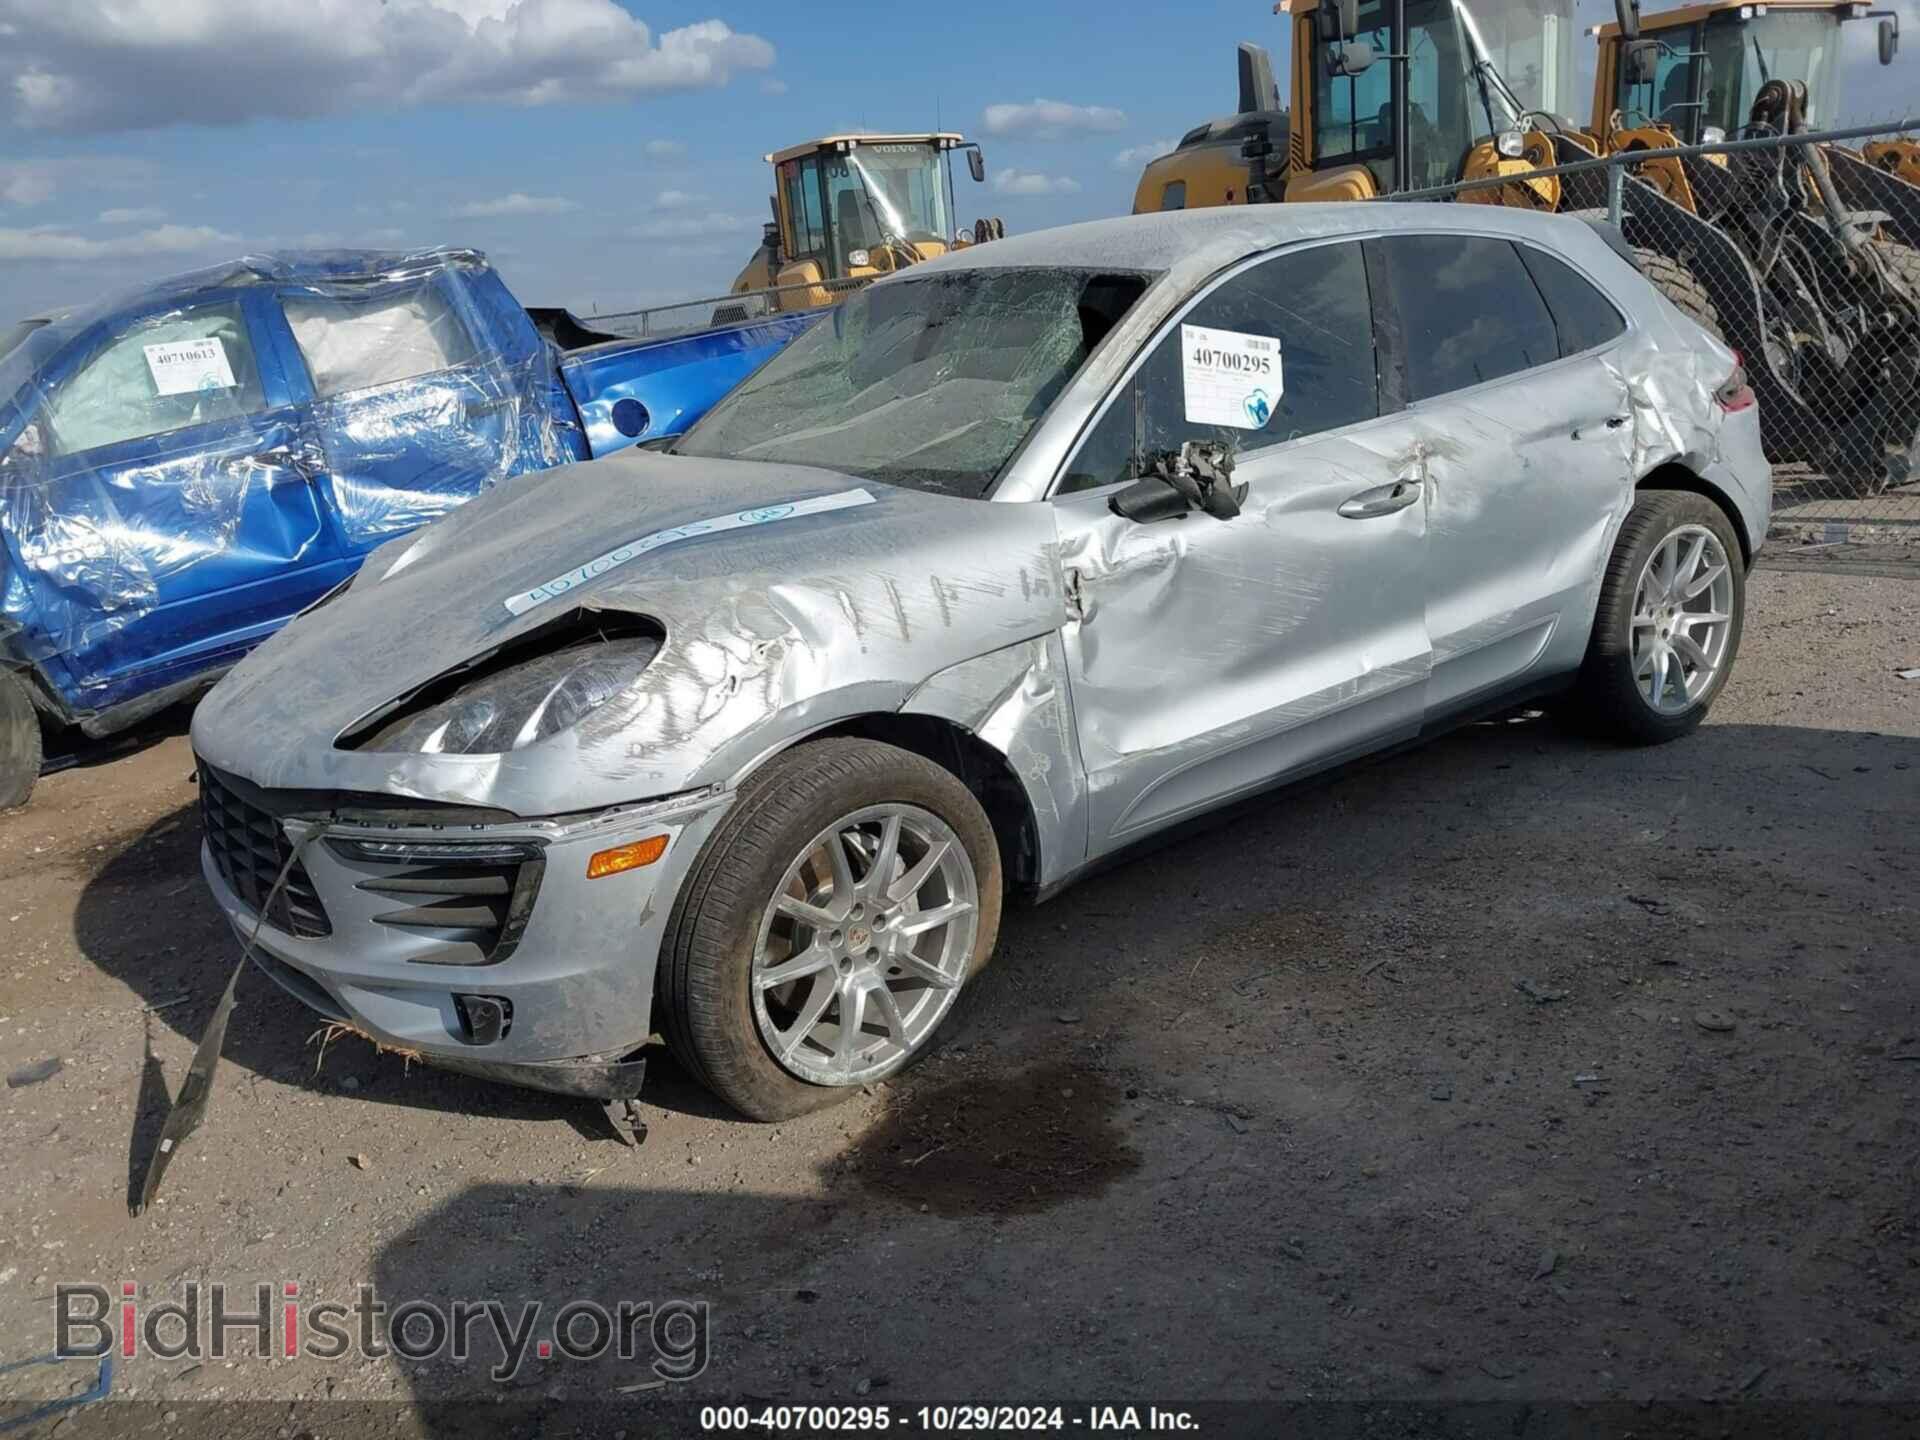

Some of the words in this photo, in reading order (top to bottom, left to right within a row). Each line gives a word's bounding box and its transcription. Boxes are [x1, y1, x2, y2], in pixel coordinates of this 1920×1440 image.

[871, 144, 917, 153] VOLVO
[157, 348, 216, 365] 40710613
[1193, 347, 1271, 374] 40700295
